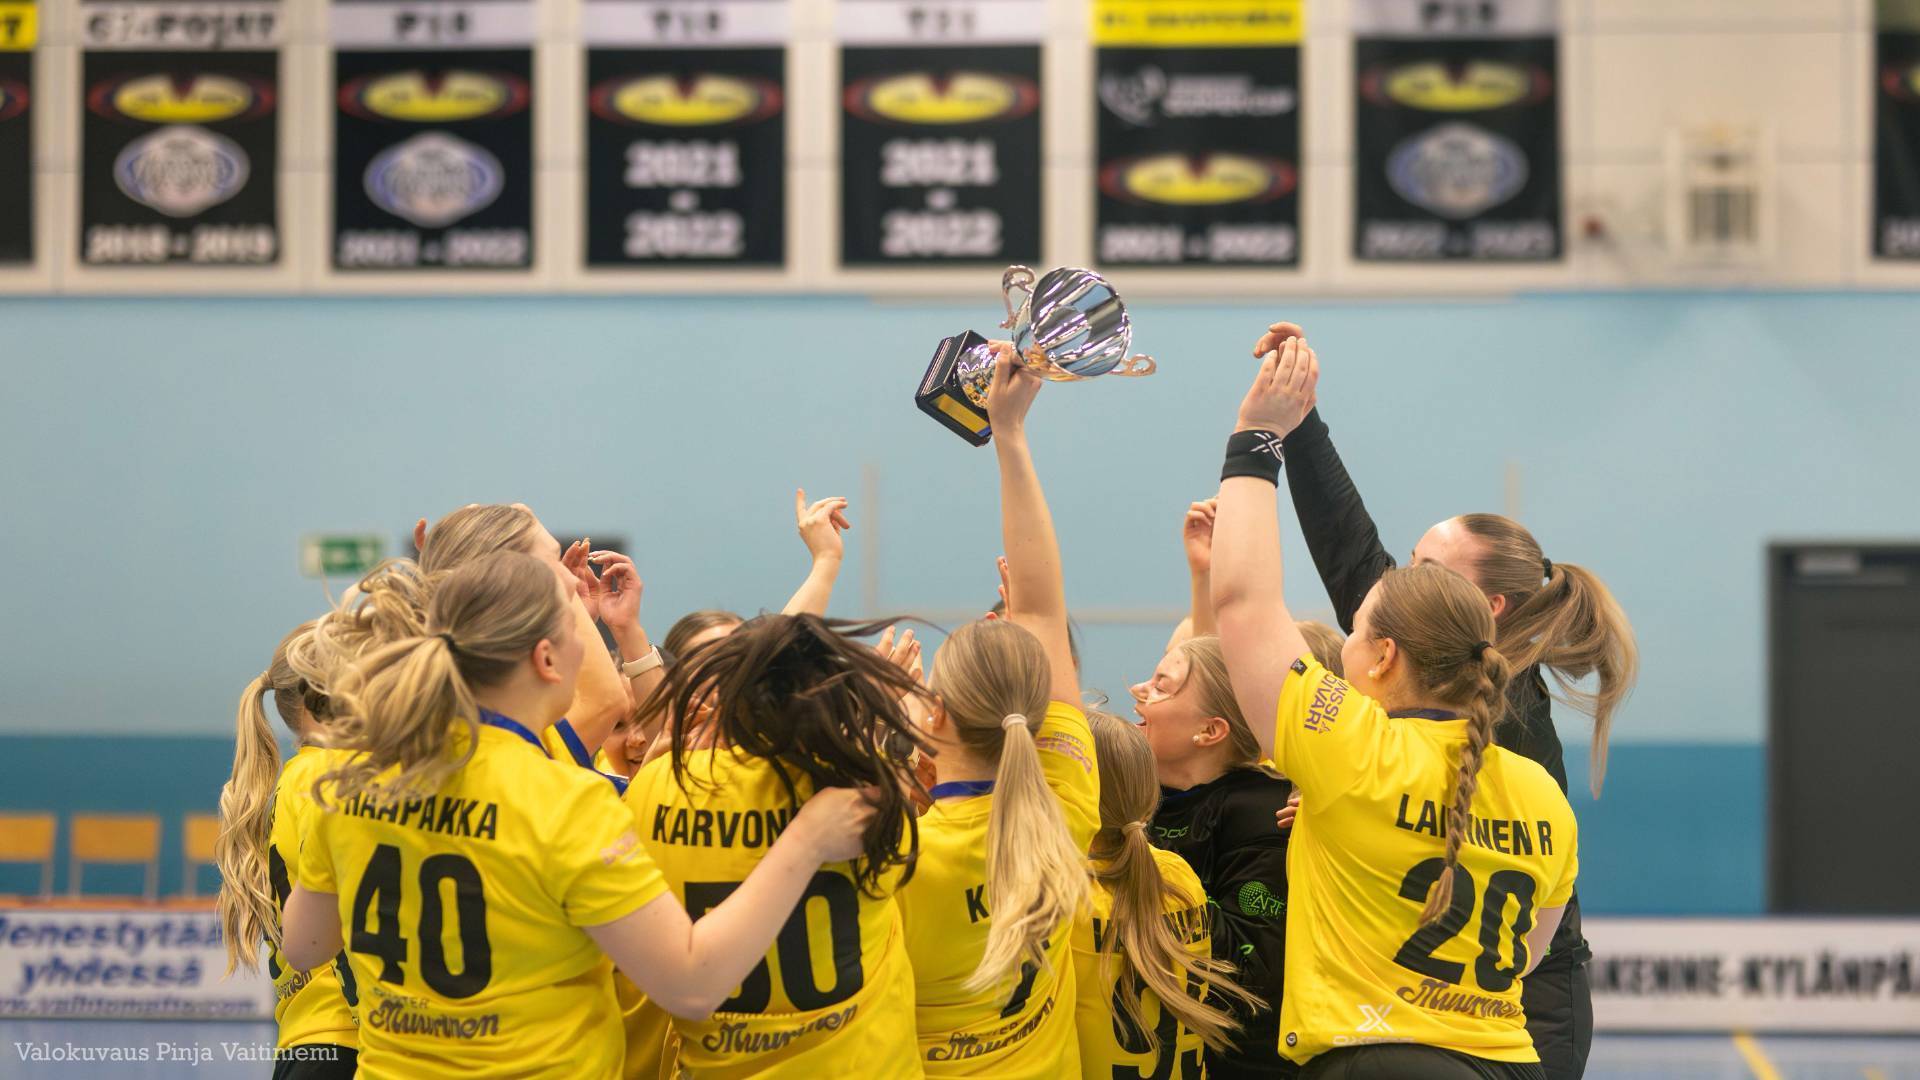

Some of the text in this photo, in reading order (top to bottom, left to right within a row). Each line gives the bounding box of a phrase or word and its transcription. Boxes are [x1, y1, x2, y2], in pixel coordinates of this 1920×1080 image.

[1304, 673, 1338, 732] DIVARI
[652, 804, 801, 848] KARVON
[1536, 820, 1553, 856] R
[351, 843, 492, 999] 40
[1393, 857, 1536, 993] 20
